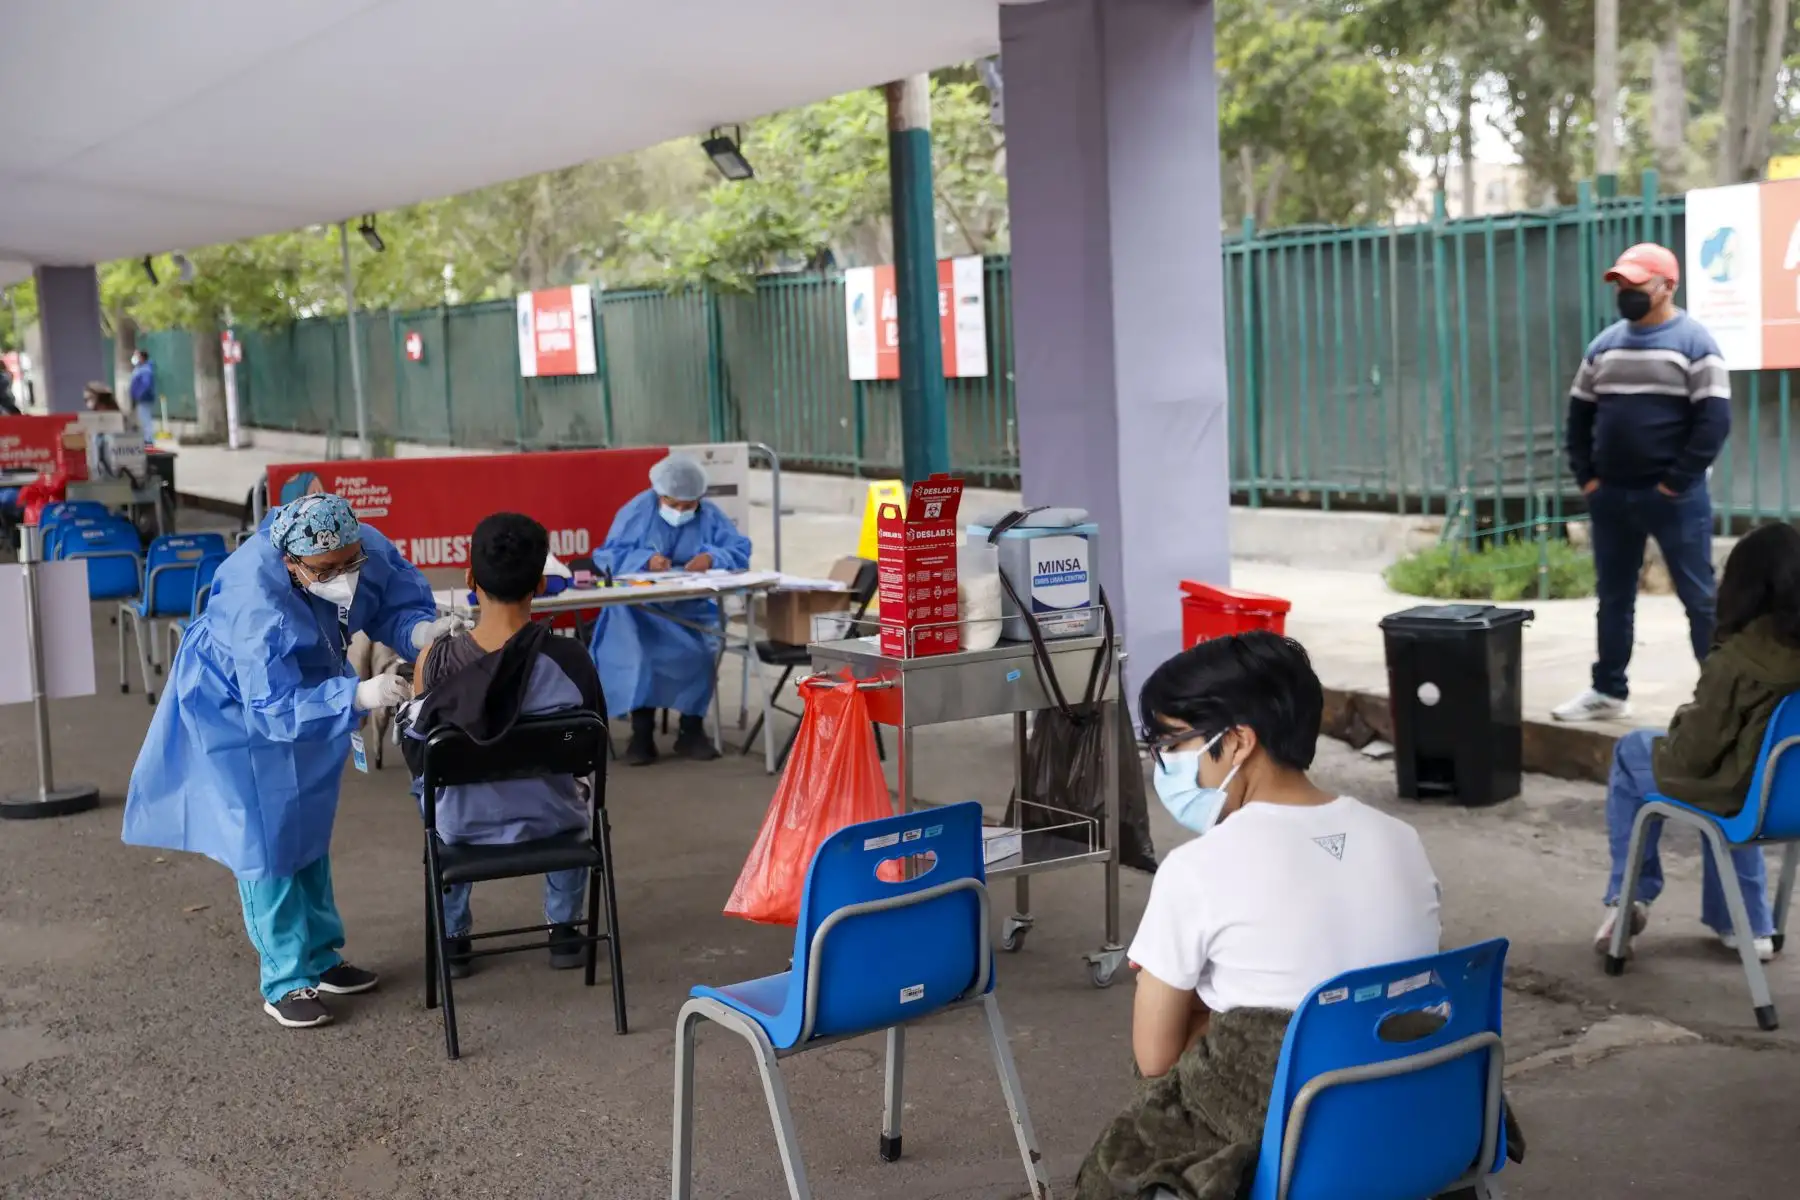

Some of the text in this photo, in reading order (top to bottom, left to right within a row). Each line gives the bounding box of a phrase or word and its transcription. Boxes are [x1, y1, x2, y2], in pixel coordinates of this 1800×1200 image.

[923, 487, 952, 495] DESLAB
[916, 529, 946, 539] DESLAB
[411, 534, 472, 565] NUEST
[549, 528, 590, 556] ADO
[1038, 558, 1081, 574] MINSA
